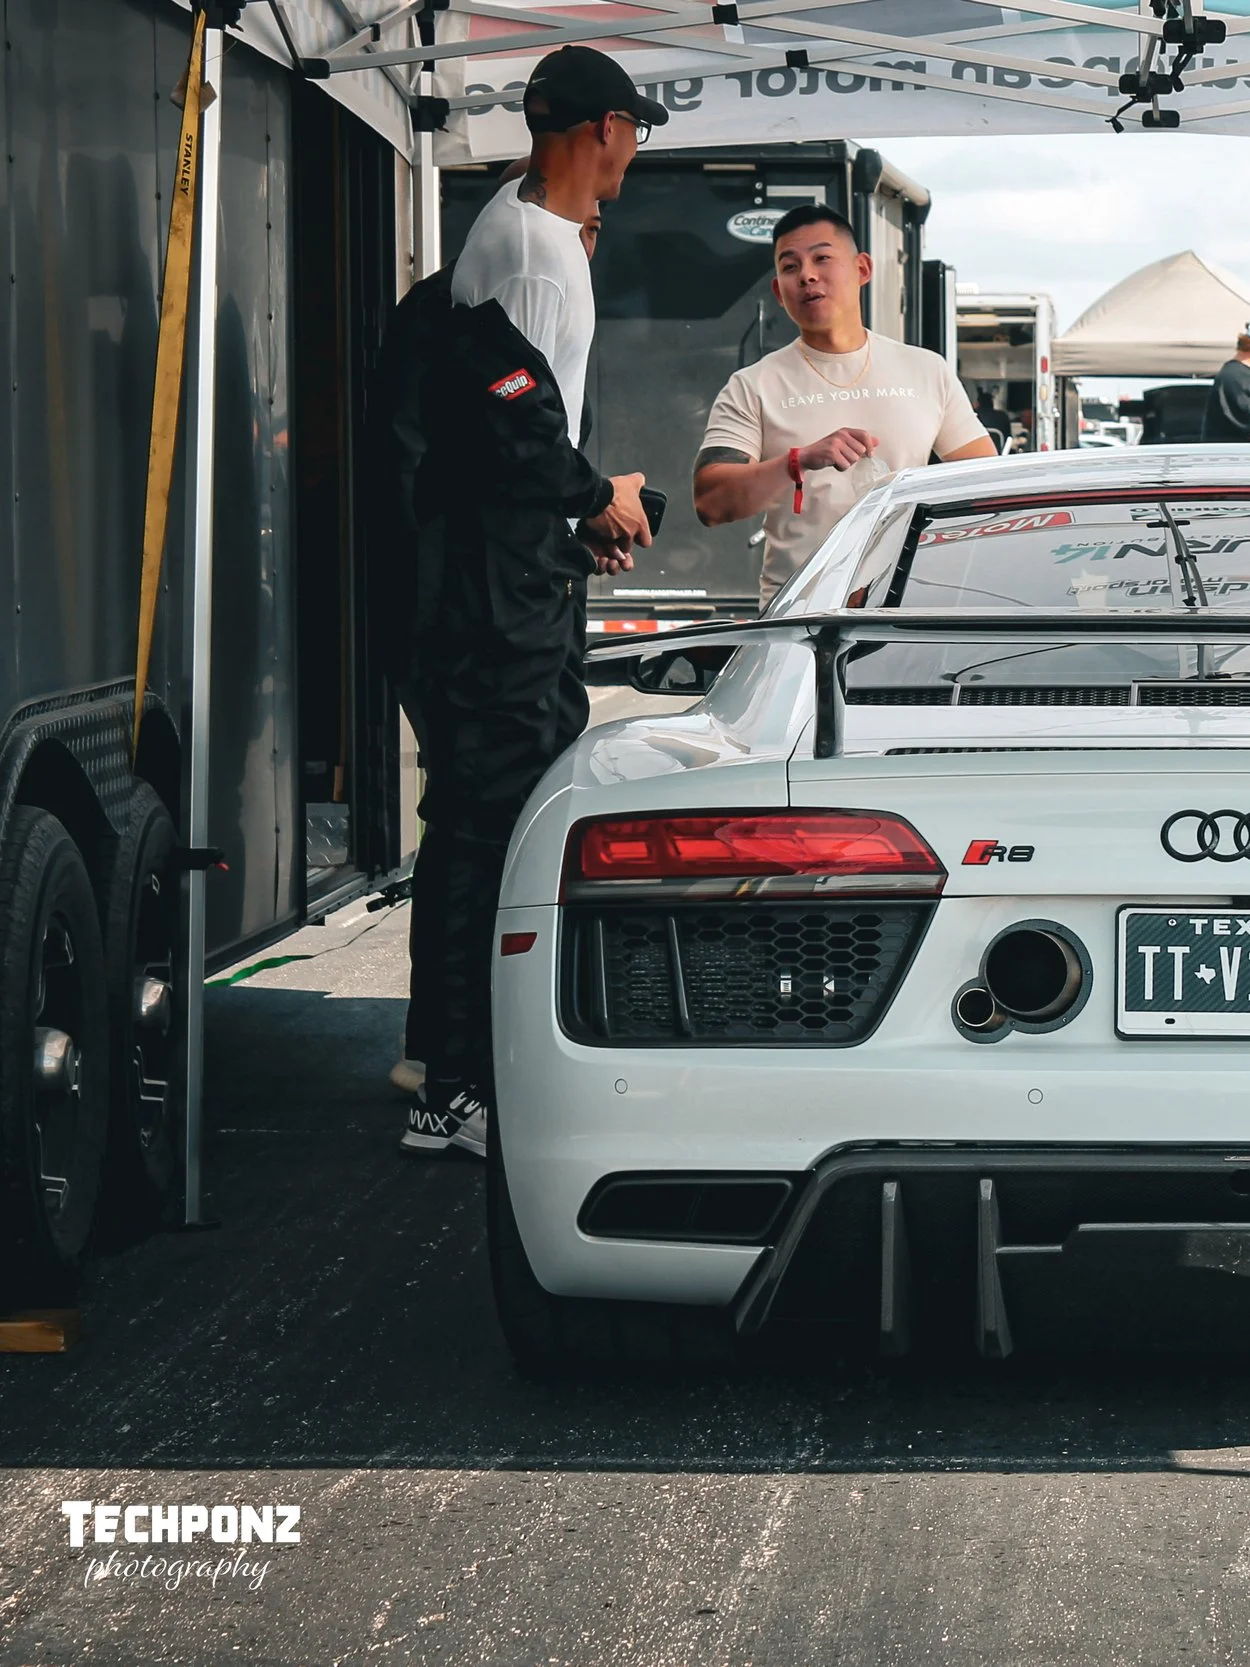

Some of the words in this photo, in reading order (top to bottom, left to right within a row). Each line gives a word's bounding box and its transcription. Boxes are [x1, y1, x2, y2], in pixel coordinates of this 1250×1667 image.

[180, 133, 193, 196] STANLEY
[781, 393, 824, 409] LEAVE
[830, 388, 871, 401] YOUR
[876, 387, 920, 399] MARK.
[972, 843, 1035, 864] R8
[1138, 945, 1190, 1001] TT
